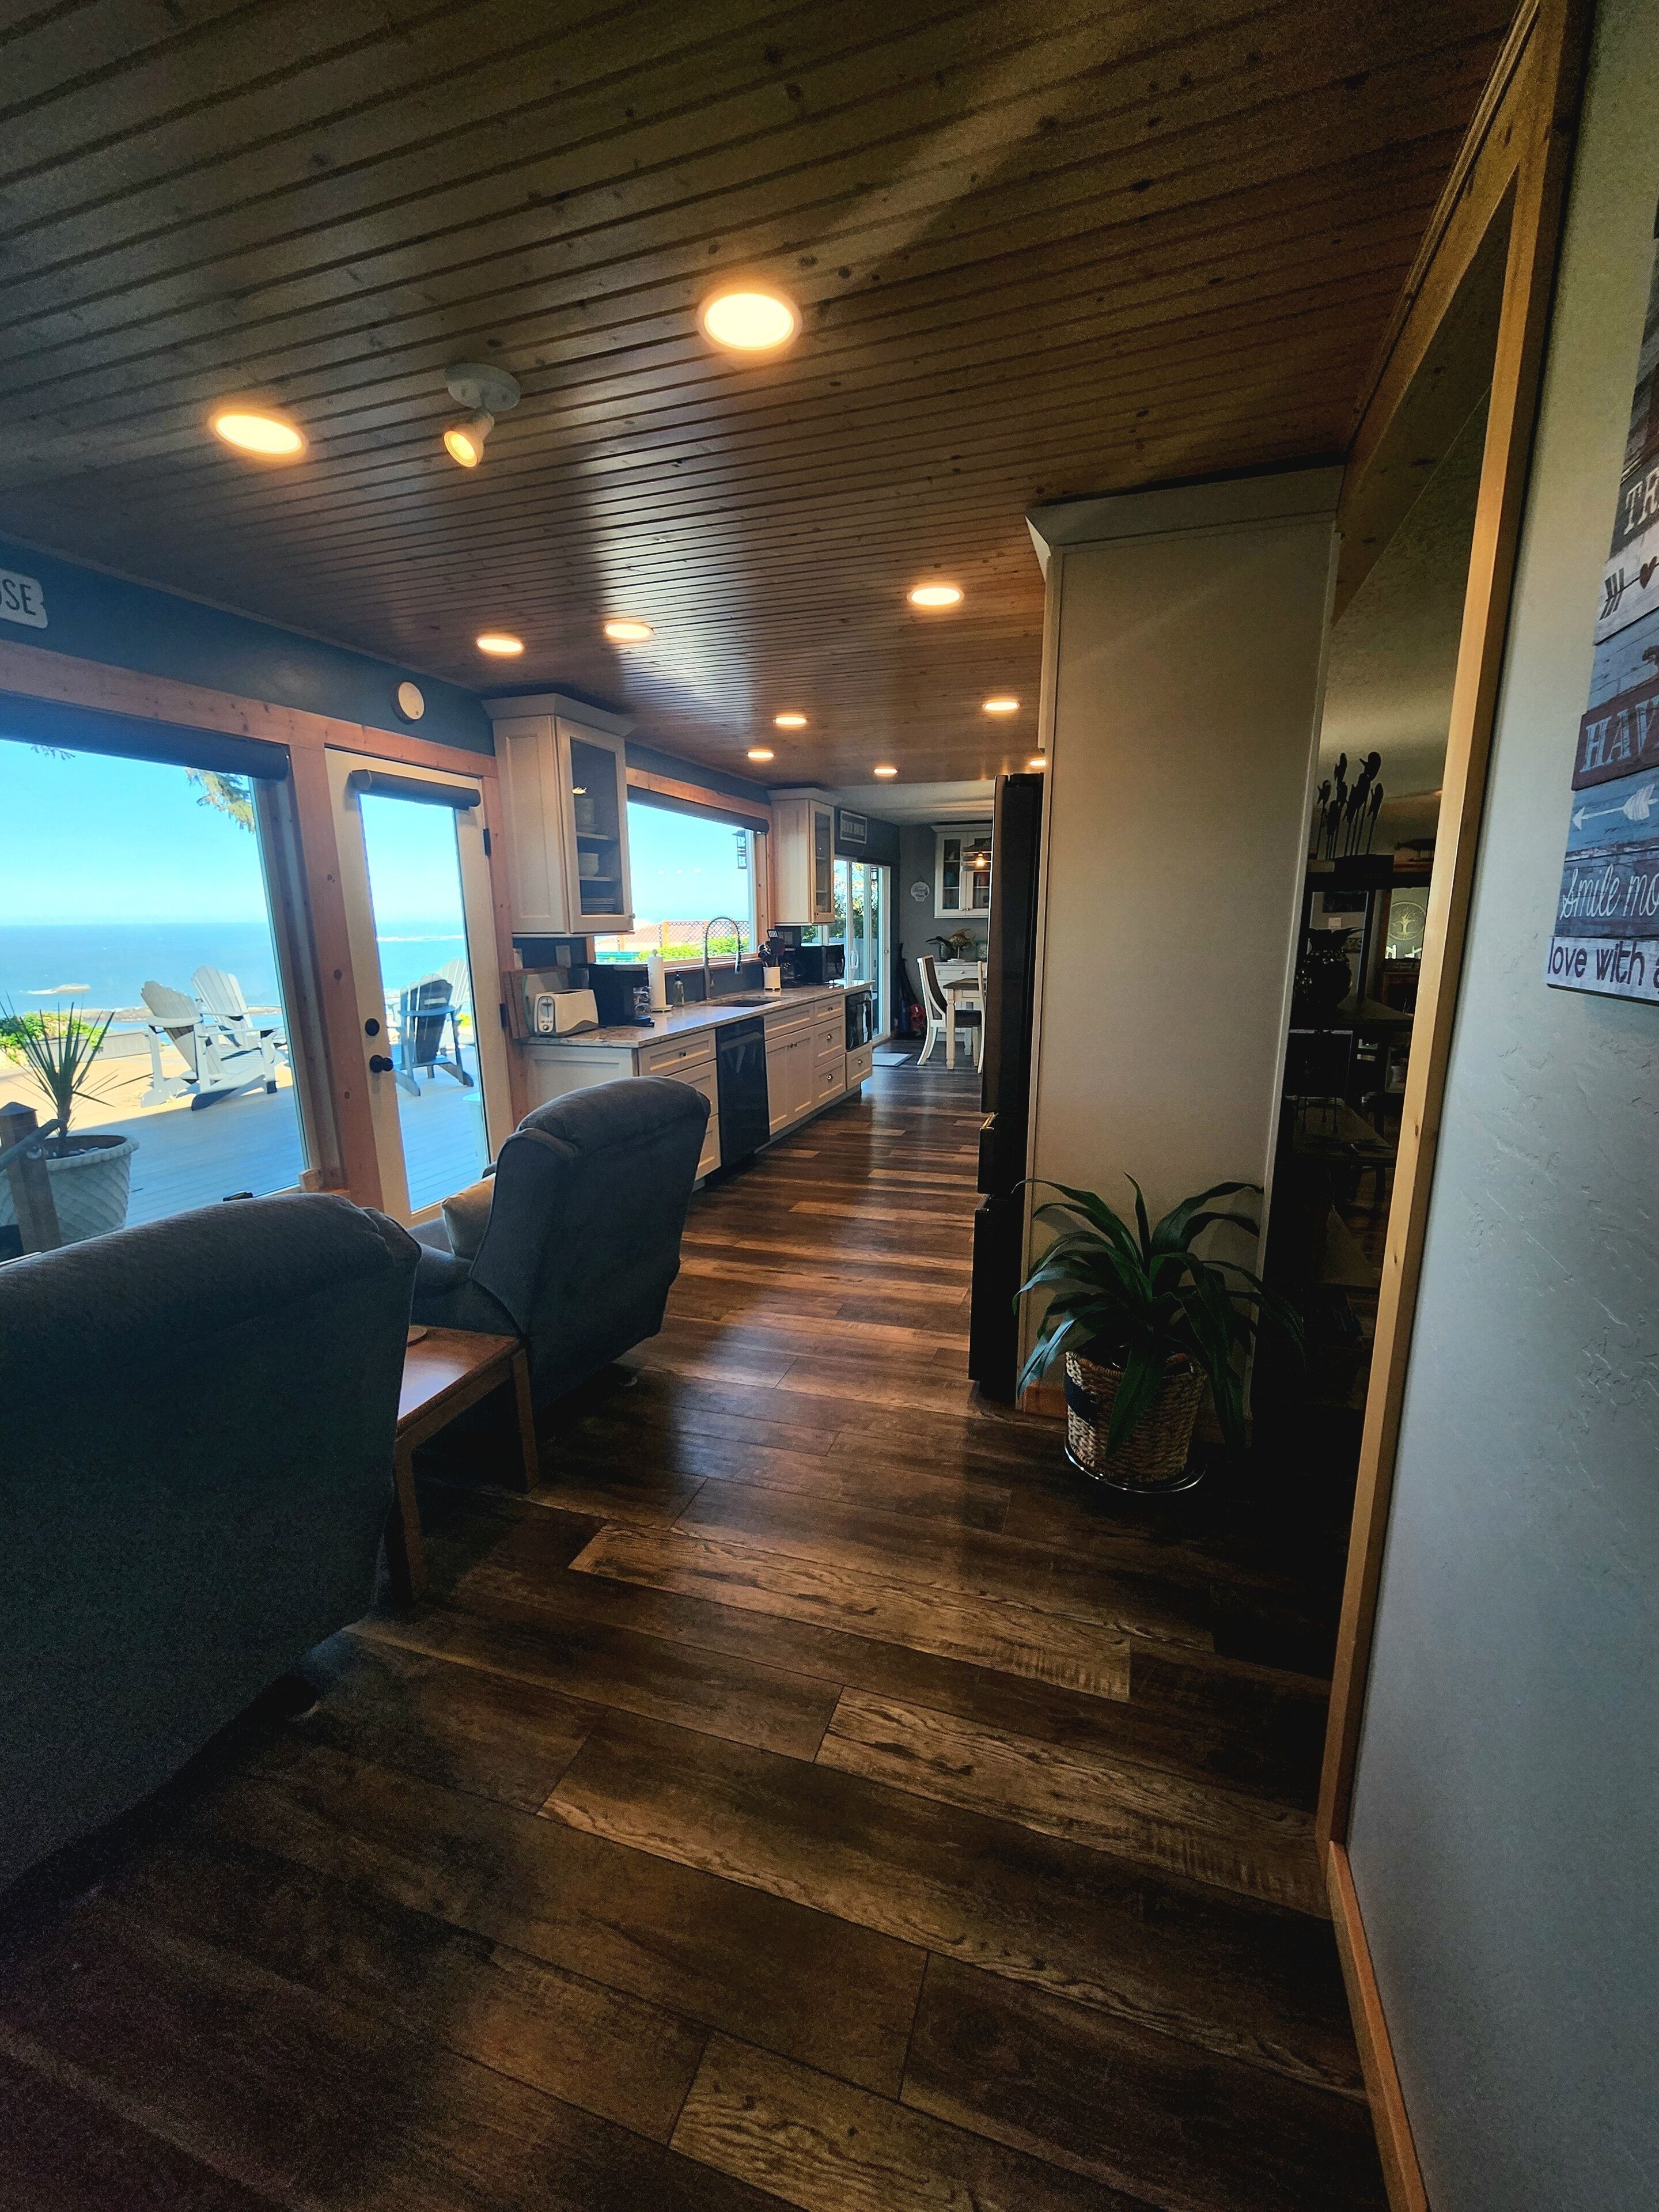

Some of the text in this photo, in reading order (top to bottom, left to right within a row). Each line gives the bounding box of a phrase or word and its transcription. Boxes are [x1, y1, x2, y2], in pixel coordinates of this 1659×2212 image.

[1623, 467, 1659, 535] TR
[0, 578, 36, 616] SE
[1580, 695, 1659, 773] HAV
[1548, 937, 1588, 978] love
[1596, 941, 1645, 986] with
